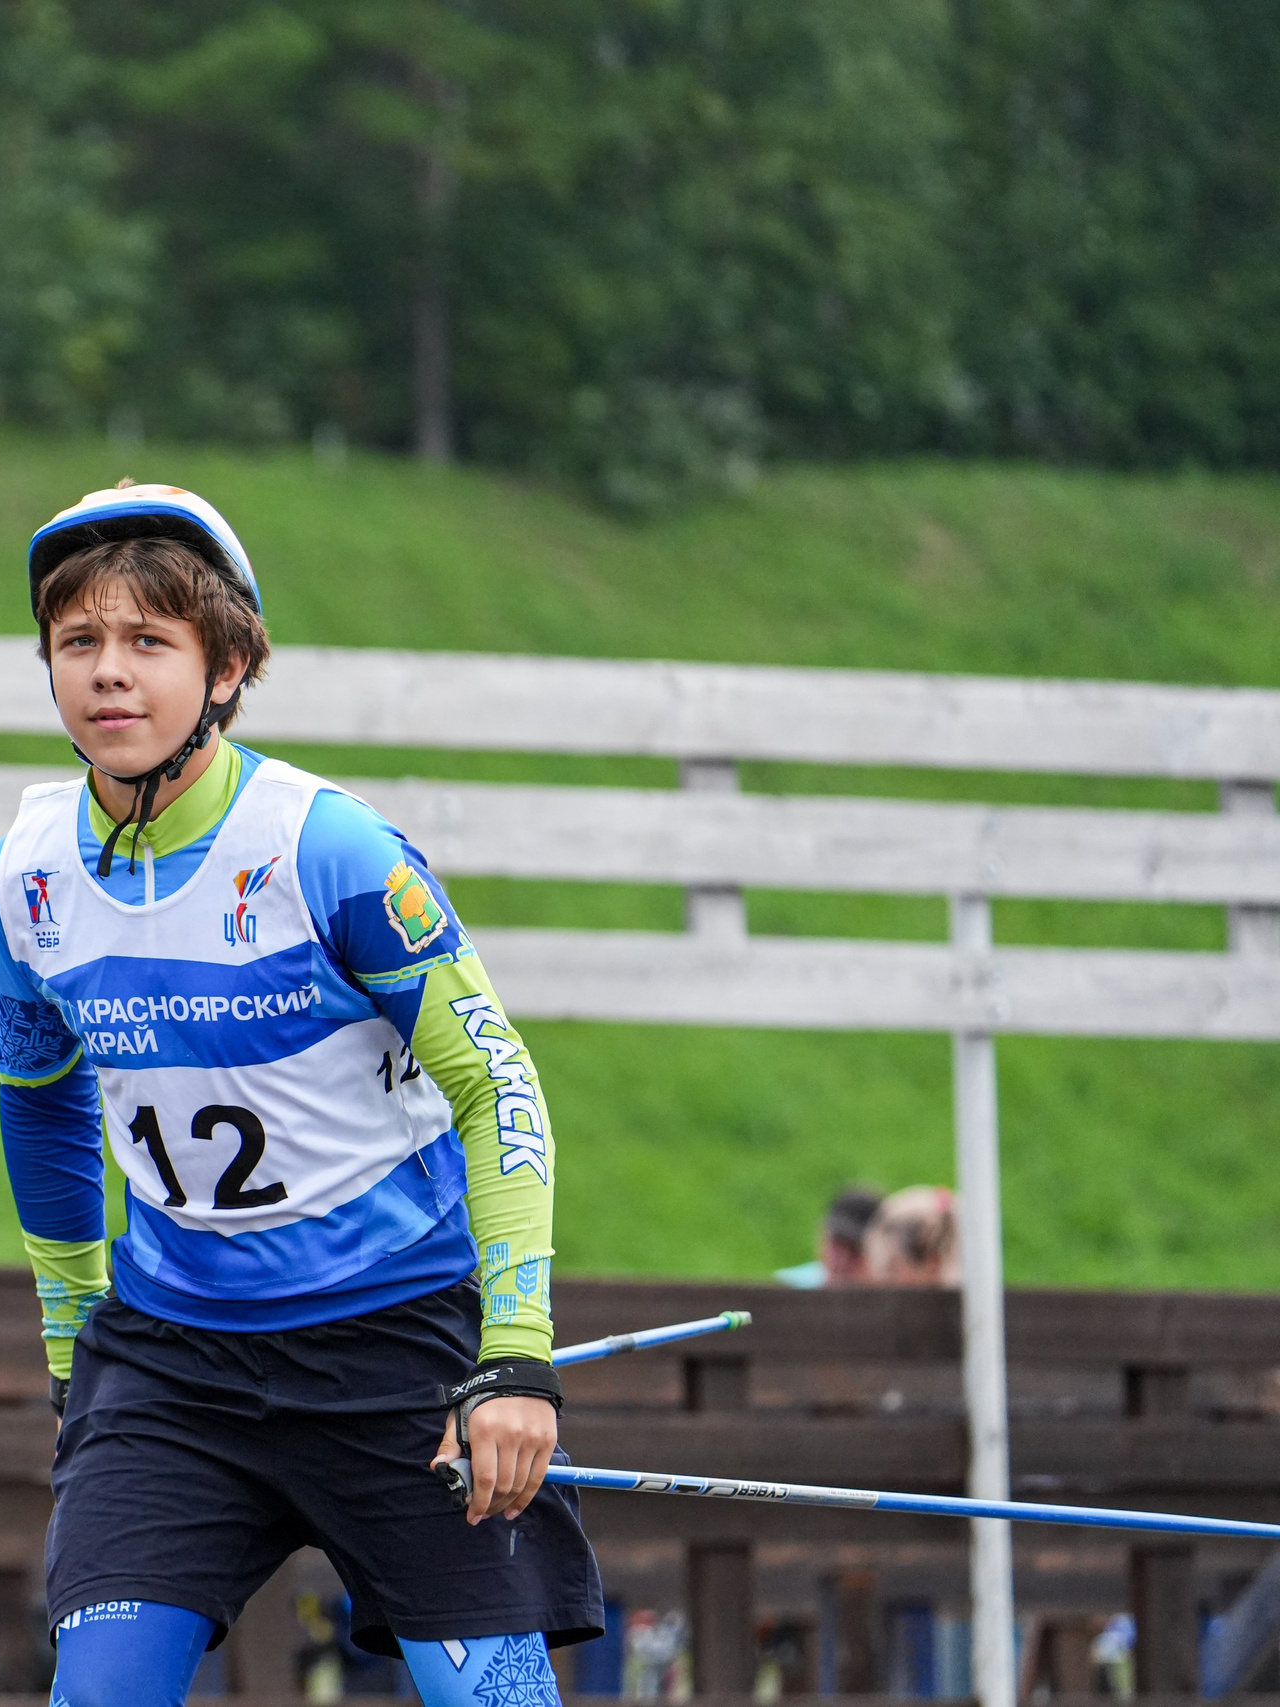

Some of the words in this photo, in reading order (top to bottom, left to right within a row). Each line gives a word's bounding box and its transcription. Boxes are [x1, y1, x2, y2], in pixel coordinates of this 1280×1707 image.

[37, 937, 60, 948] СБР
[77, 982, 322, 1024] КРАСНОЯРСКИЙ
[83, 1024, 159, 1055] КРАЙ
[376, 1043, 421, 1094] 12
[449, 993, 548, 1186] КАНСК
[127, 1104, 289, 1210] 12
[737, 1481, 789, 1500] CYBER
[84, 1613, 138, 1623] LABORATORY
[85, 1601, 142, 1615] SPORT
